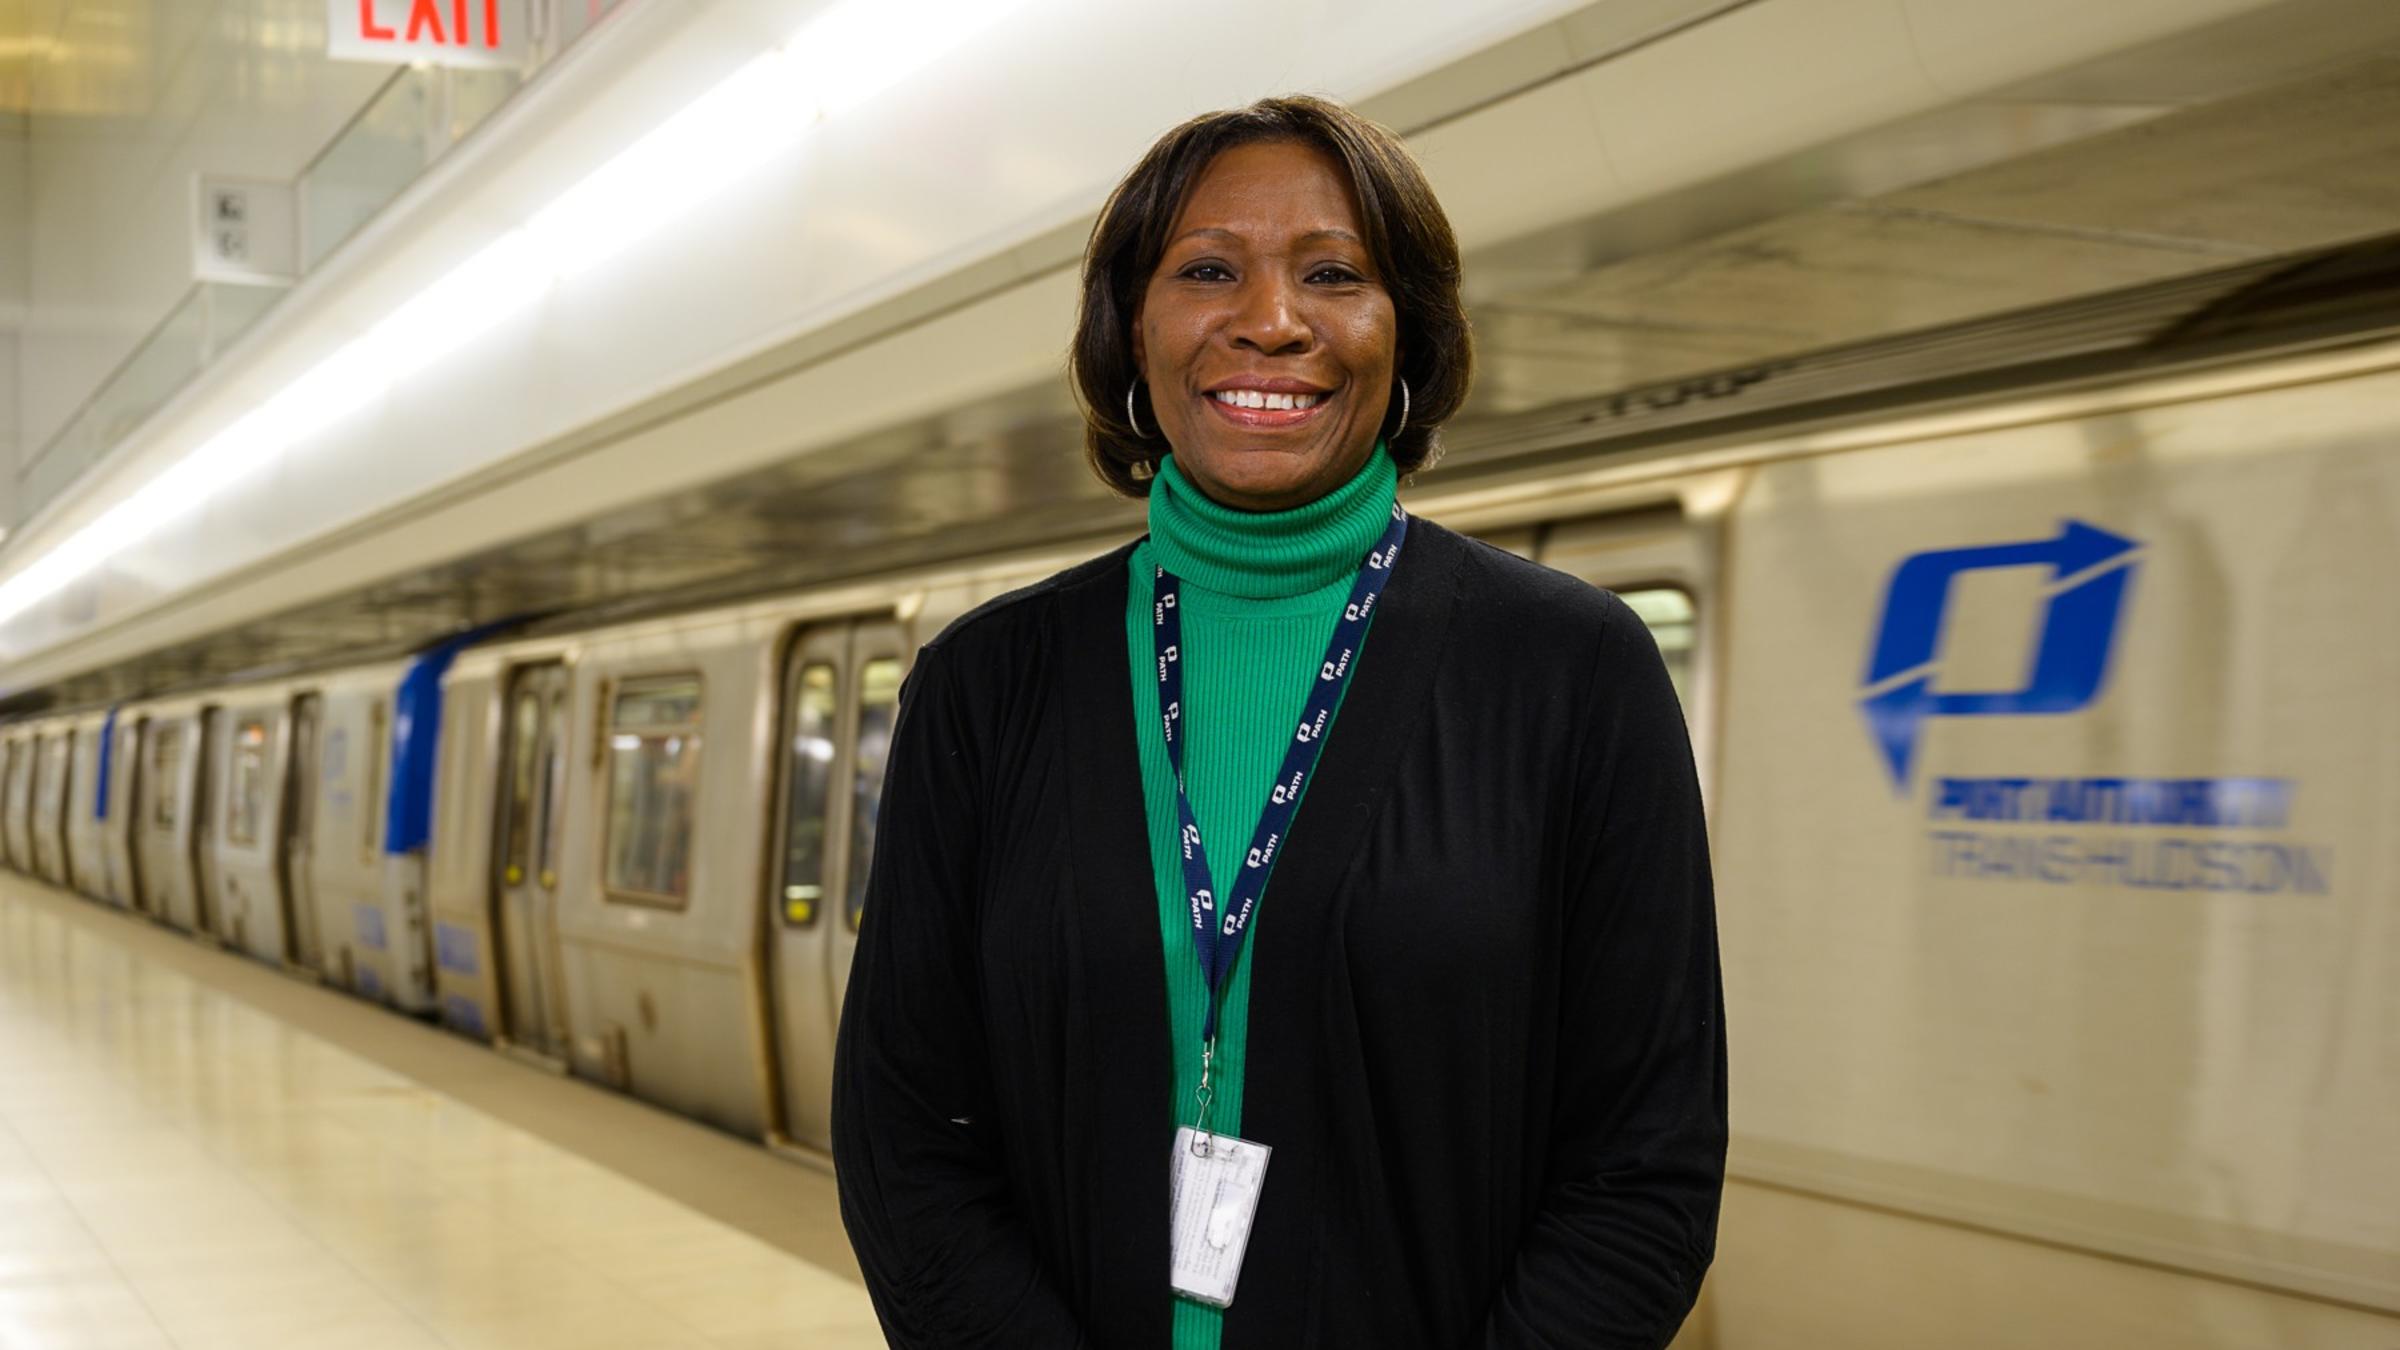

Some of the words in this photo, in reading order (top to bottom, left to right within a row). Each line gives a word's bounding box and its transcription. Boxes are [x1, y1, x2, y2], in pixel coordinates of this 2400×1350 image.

[1382, 544, 1398, 568] PATH
[1156, 602, 1164, 625] PATH
[1360, 592, 1376, 618] PATH
[1159, 655, 1167, 682] PATH
[1336, 649, 1351, 678] PATH
[1163, 713, 1173, 742] PATH
[1312, 709, 1328, 738] PATH
[1287, 771, 1303, 800] PATH
[1183, 828, 1192, 860] PATH
[1262, 834, 1278, 863] PATH
[1191, 897, 1202, 929] PATH
[1237, 898, 1253, 929] PATH
